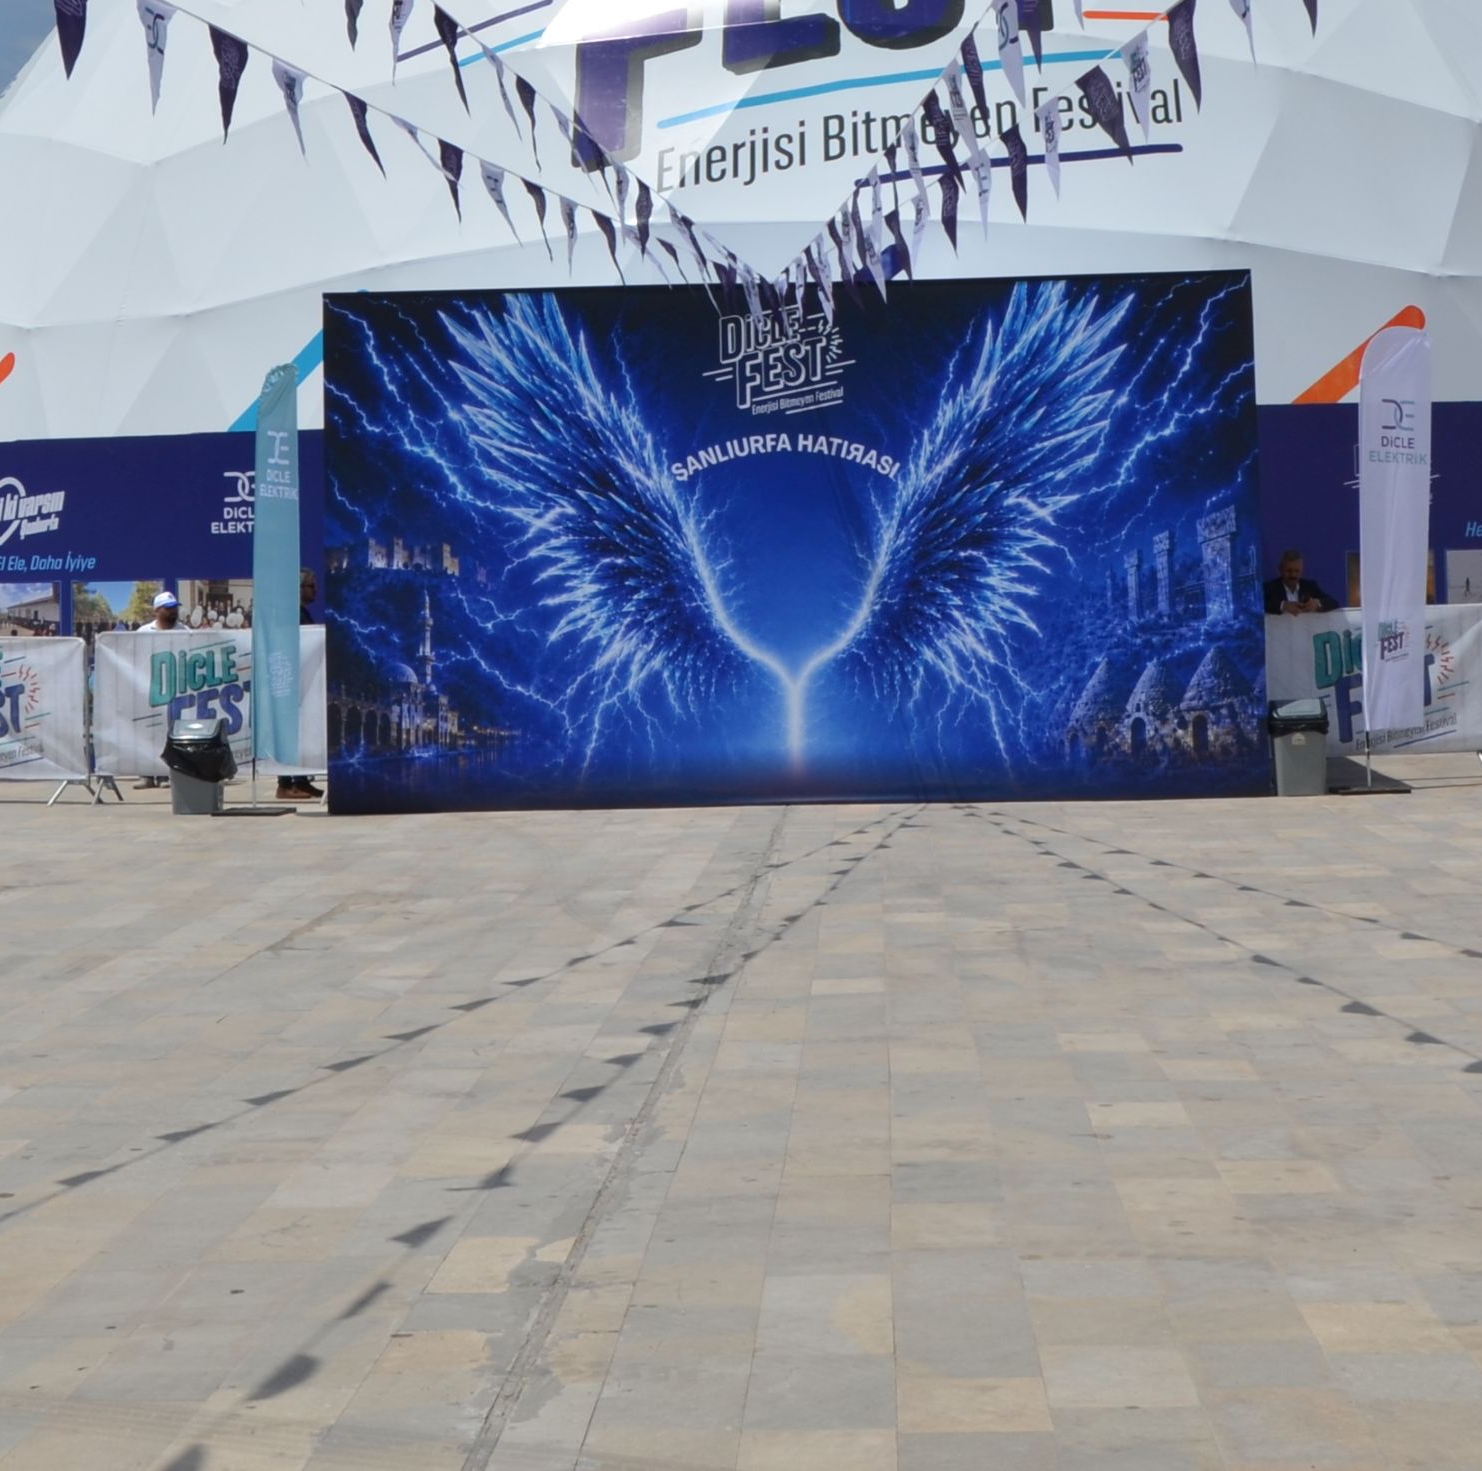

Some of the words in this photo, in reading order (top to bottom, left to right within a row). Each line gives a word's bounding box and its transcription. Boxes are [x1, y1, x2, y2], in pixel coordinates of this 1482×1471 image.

[656, 121, 807, 194] Enerjisi
[1033, 79, 1182, 133] Fesival
[736, 336, 827, 409] FEST
[671, 433, 793, 482] ŞANLIURFA
[211, 521, 255, 534] ELEKT
[223, 506, 255, 520] DiCL
[7, 556, 26, 574] Ele,
[30, 555, 63, 572] Daha
[65, 550, 96, 574] İyiye
[1380, 631, 1404, 661] FEST
[167, 681, 252, 736] FES
